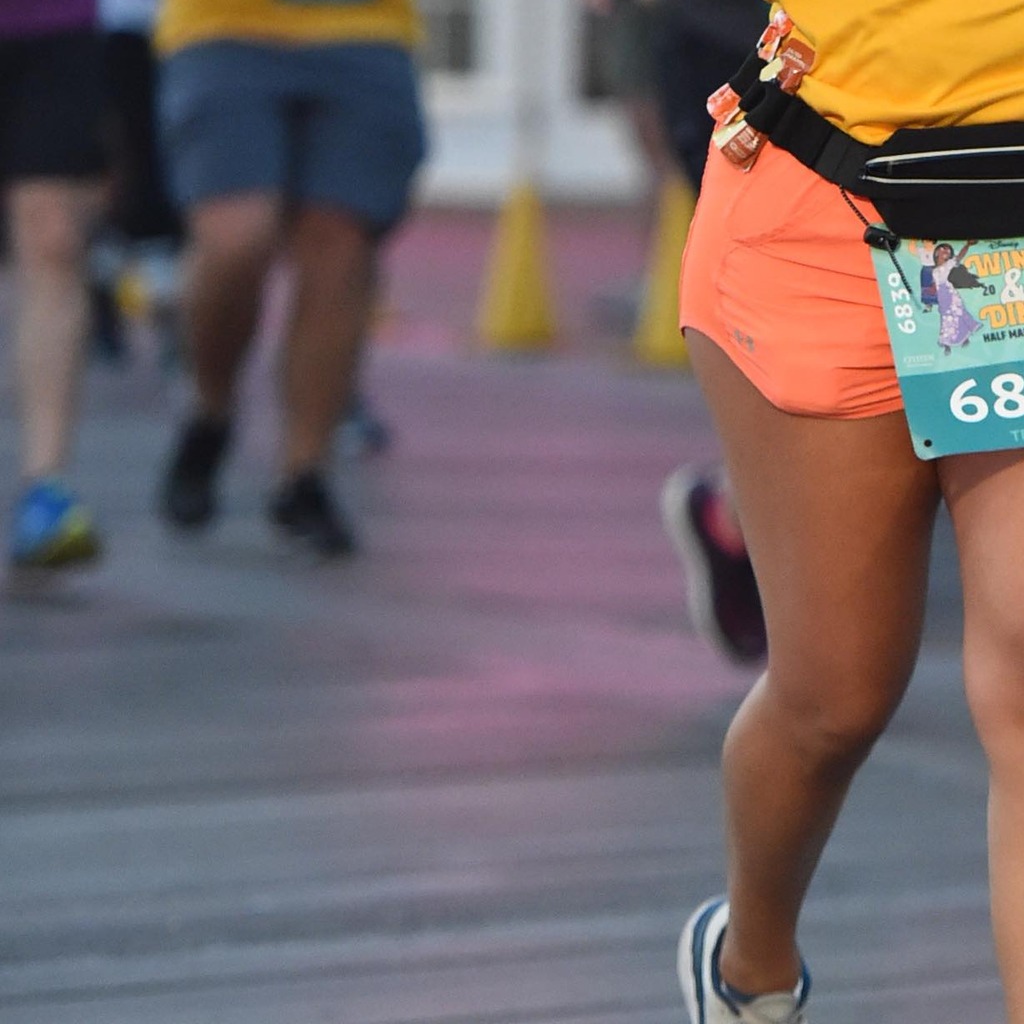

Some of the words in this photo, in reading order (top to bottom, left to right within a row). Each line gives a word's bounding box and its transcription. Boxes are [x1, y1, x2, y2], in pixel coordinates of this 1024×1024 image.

[982, 284, 996, 297] 20
[888, 272, 916, 334] 6839
[983, 329, 1006, 343] HALF
